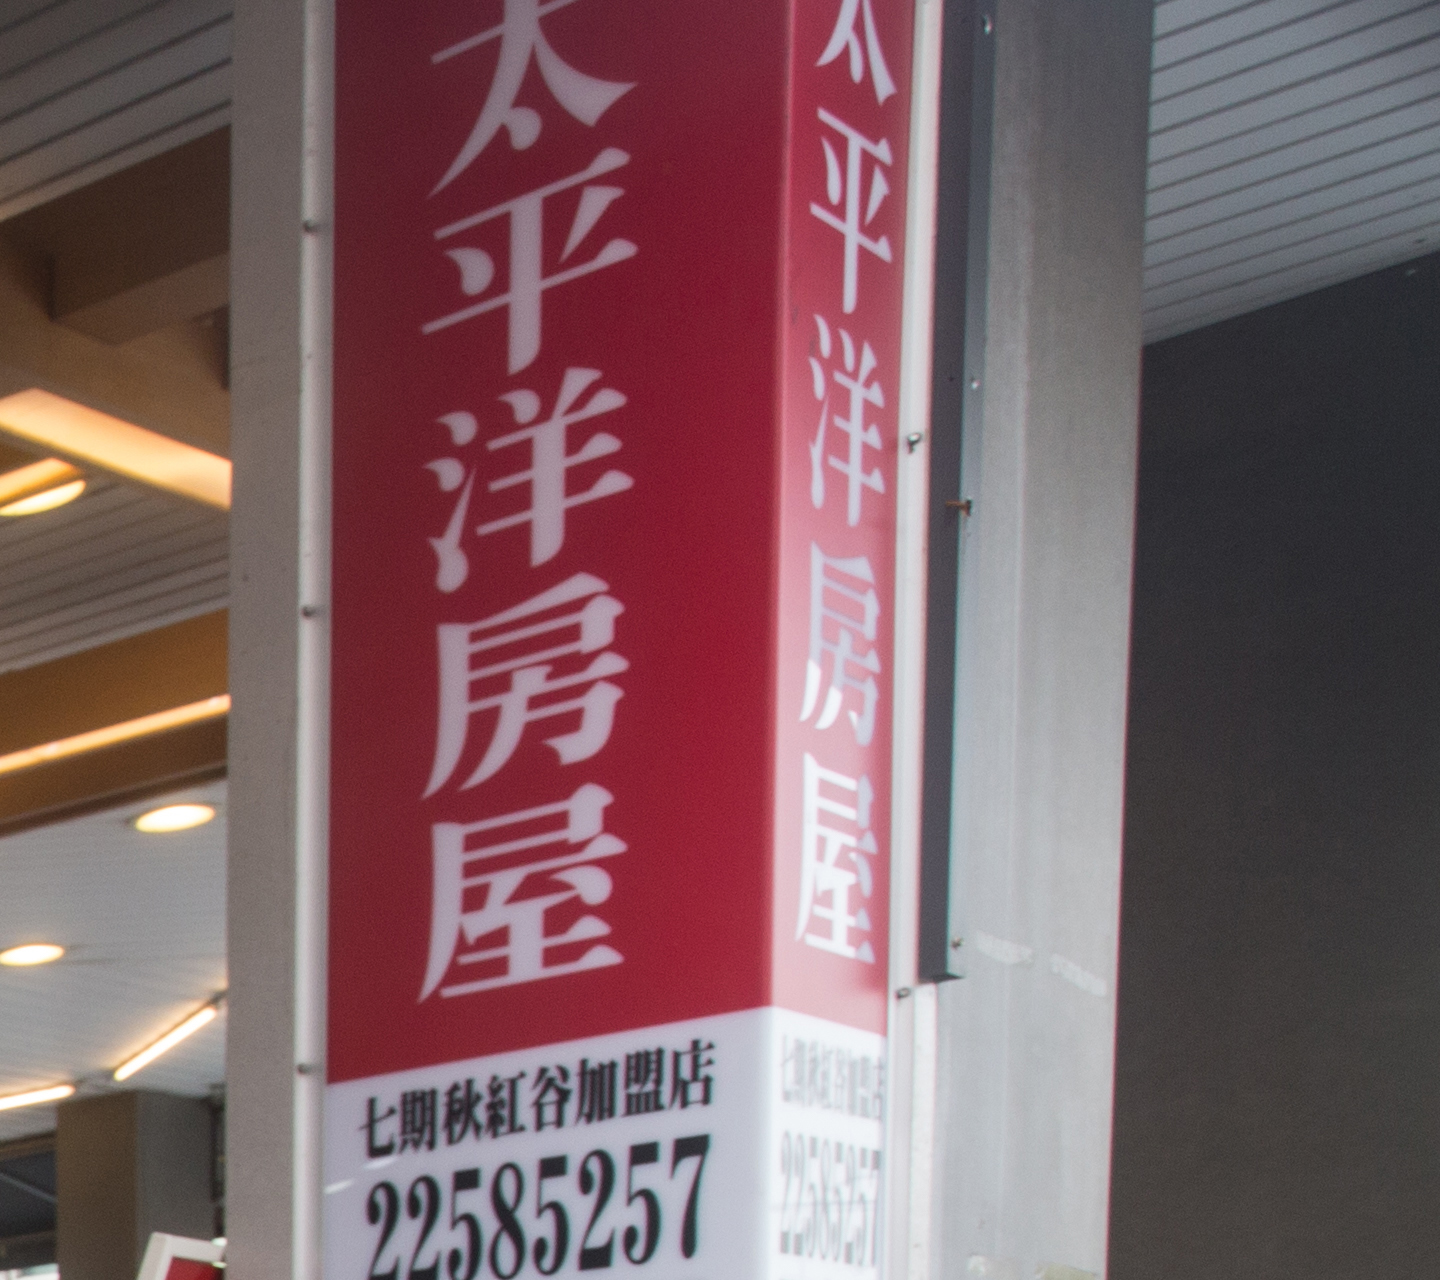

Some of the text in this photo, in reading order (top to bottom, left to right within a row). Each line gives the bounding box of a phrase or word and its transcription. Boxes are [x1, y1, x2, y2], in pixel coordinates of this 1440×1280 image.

[421, 0, 639, 1002] 太平洋房屋
[357, 1038, 716, 1160] 七期秋紅谷加盟店
